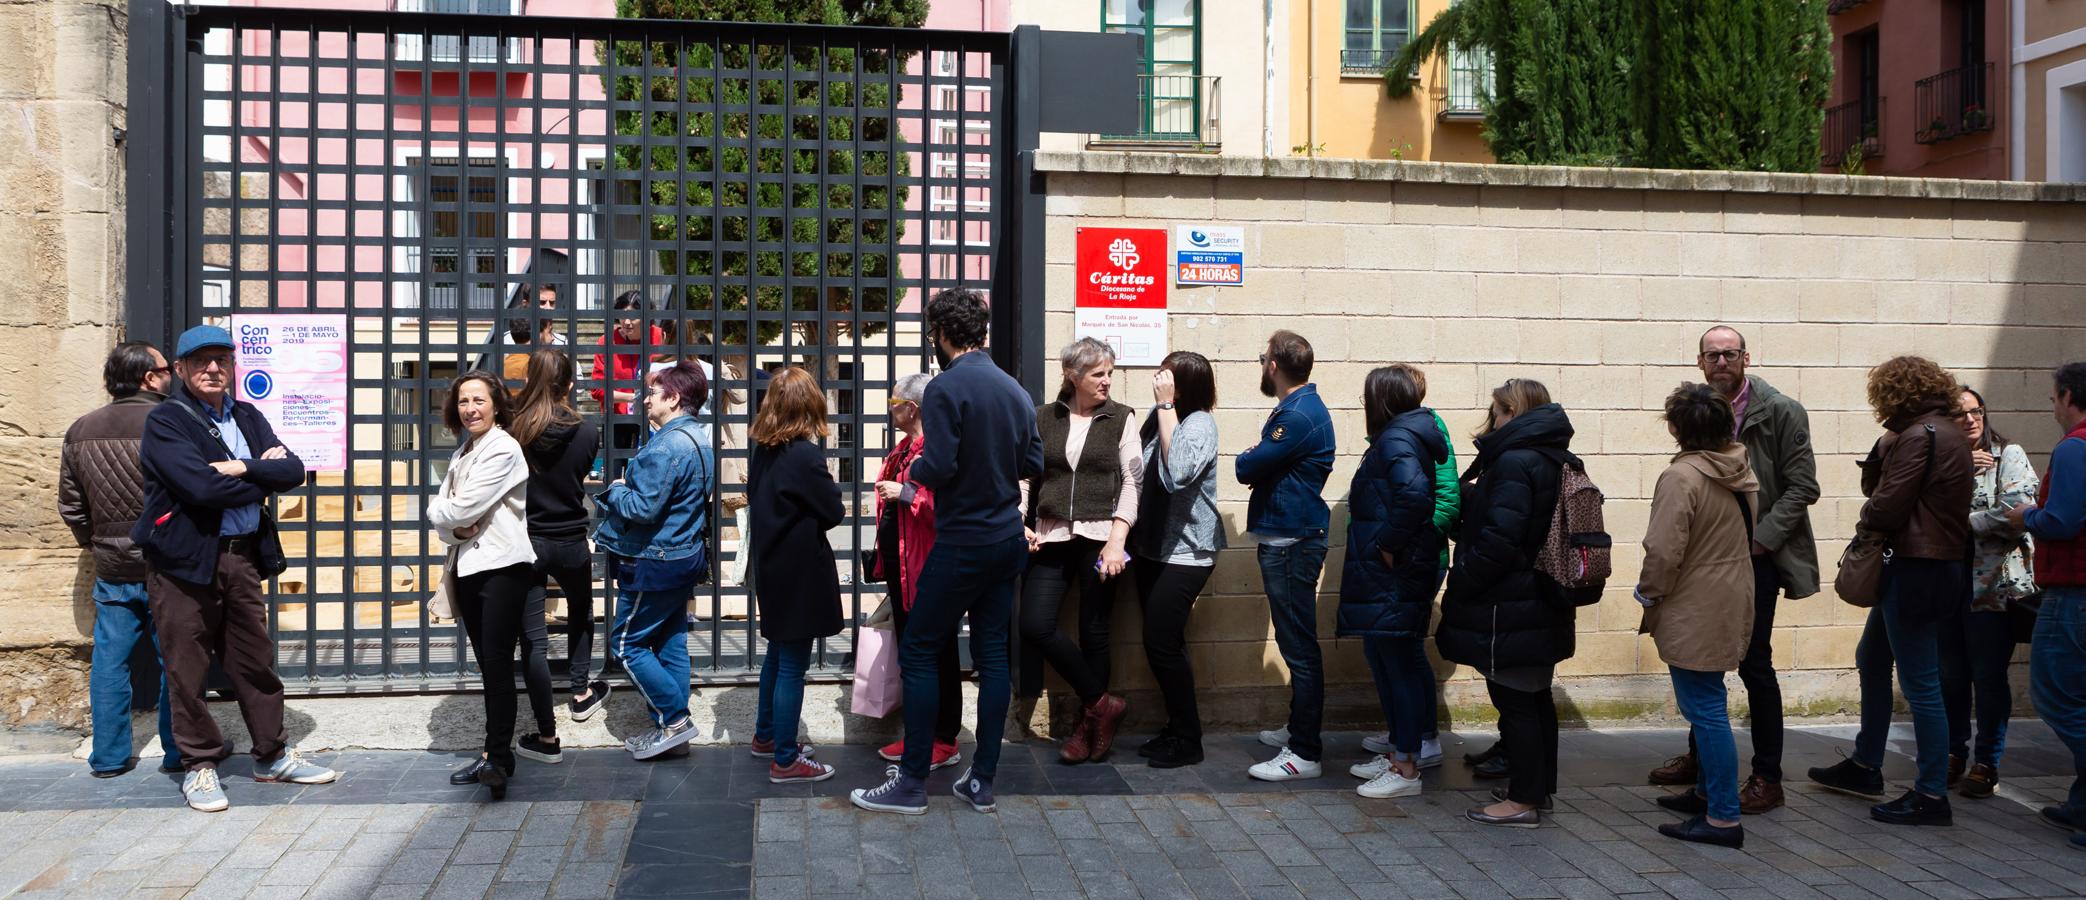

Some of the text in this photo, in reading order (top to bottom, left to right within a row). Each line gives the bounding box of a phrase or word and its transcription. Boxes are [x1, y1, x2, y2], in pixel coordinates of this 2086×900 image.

[1090, 272, 1154, 285] Cáritas
[1182, 268, 1238, 281] 24 HORAS
[1119, 293, 1136, 301] Rioja
[241, 325, 269, 335] Con
[242, 344, 272, 354] trico
